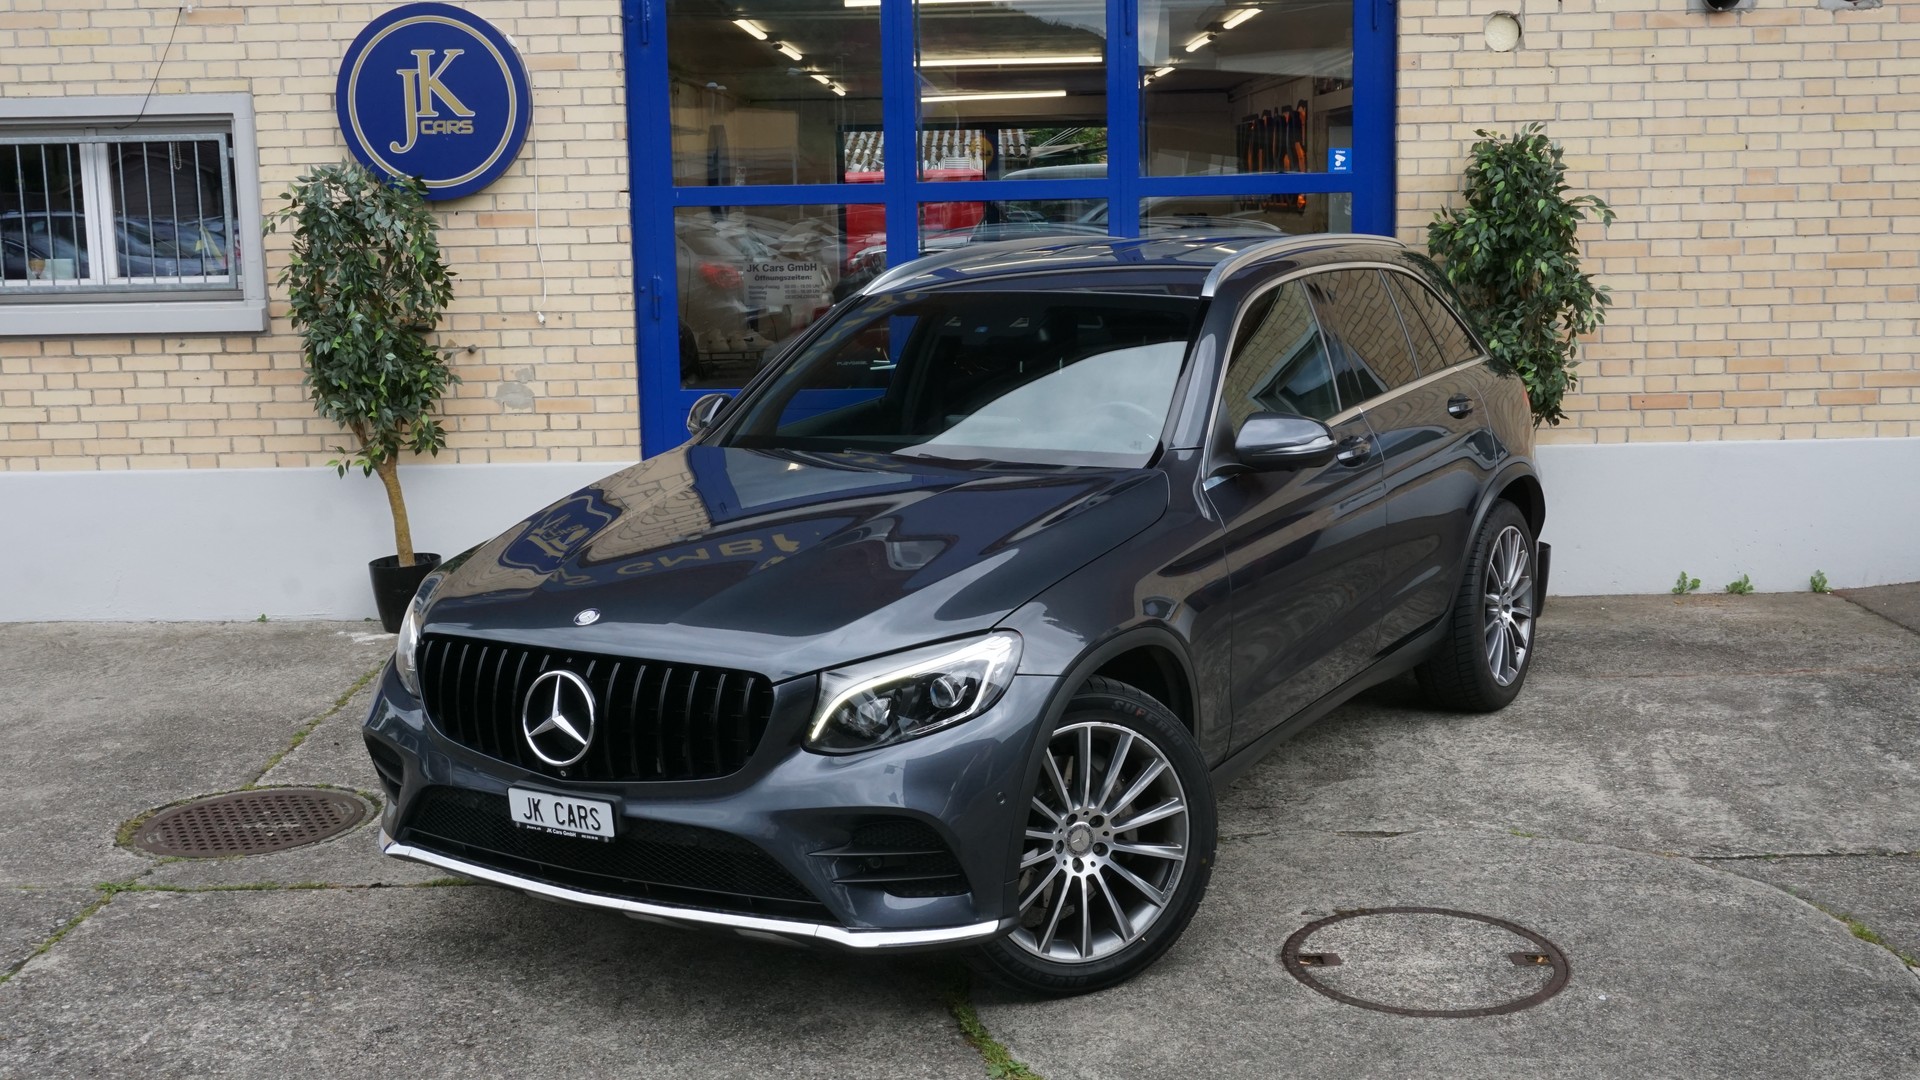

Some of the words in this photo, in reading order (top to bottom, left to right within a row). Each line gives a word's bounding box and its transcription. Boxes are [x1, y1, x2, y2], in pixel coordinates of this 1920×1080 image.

[389, 49, 476, 154] JK
[420, 120, 474, 135] CARS
[746, 264, 760, 273] JK
[762, 263, 785, 272] Cars
[787, 263, 817, 272] GmbH
[754, 274, 813, 282] Öffnungszeiten:
[523, 797, 544, 823] JK
[554, 802, 601, 831] CARS
